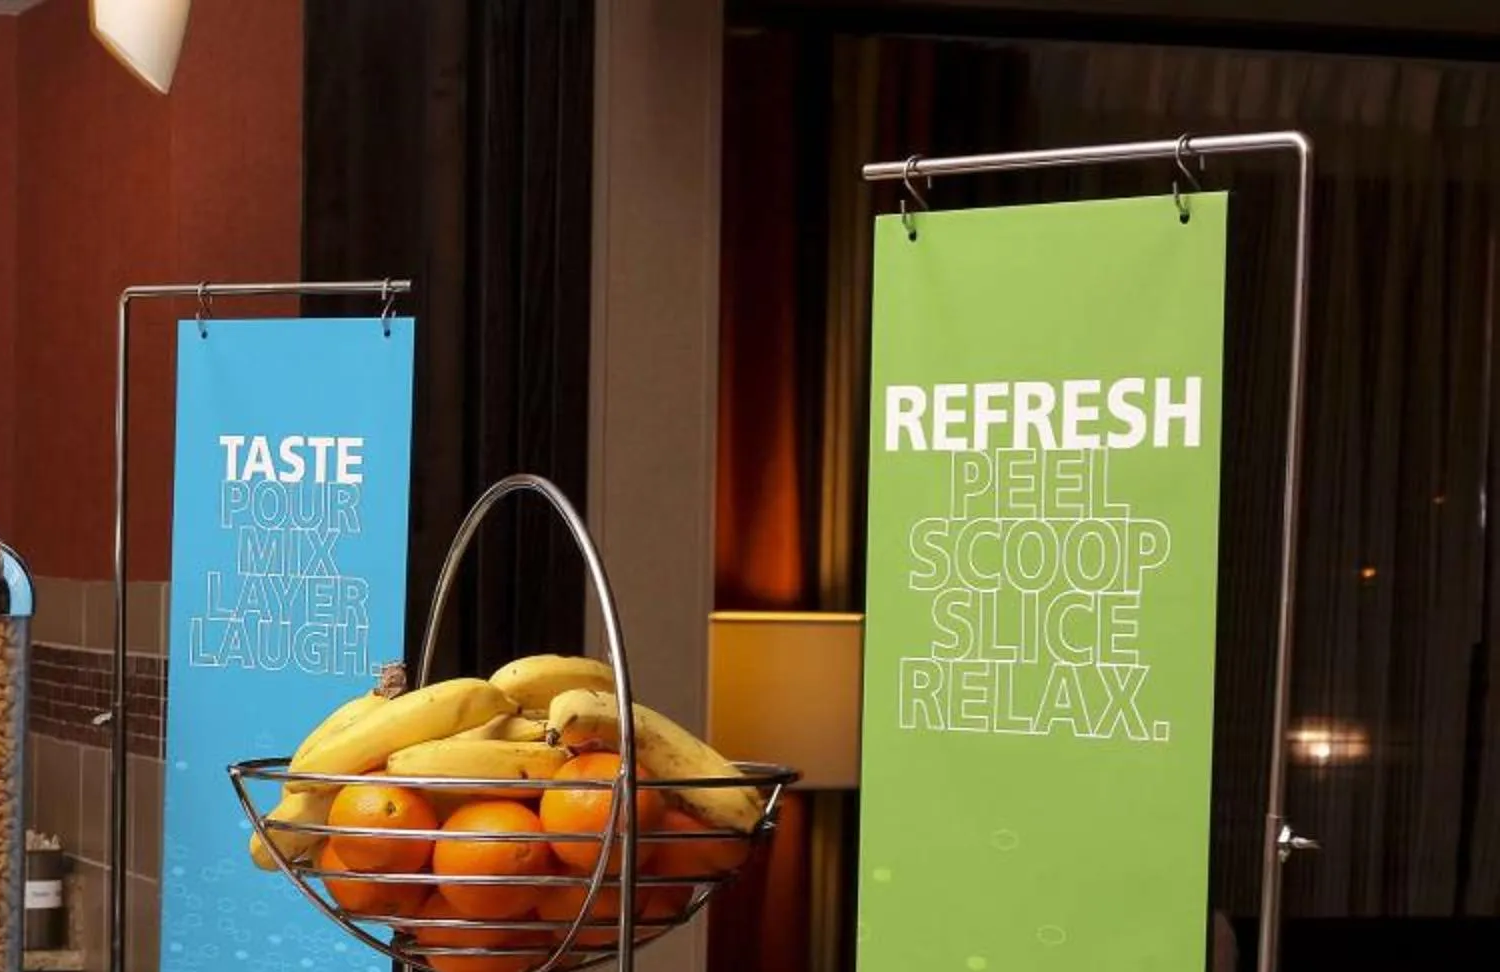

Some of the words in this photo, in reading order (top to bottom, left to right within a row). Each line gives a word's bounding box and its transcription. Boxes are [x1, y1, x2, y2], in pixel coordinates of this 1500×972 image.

[884, 376, 1202, 452] REFRESH
[219, 435, 364, 484] TASTE
[950, 447, 1130, 521] PEEL
[221, 479, 361, 533] POUR
[237, 525, 340, 577] MIX
[909, 517, 1172, 594] SCOOP
[207, 571, 370, 628] LAYER
[931, 587, 1141, 667] SLICE
[899, 658, 1171, 742] RELAX.
